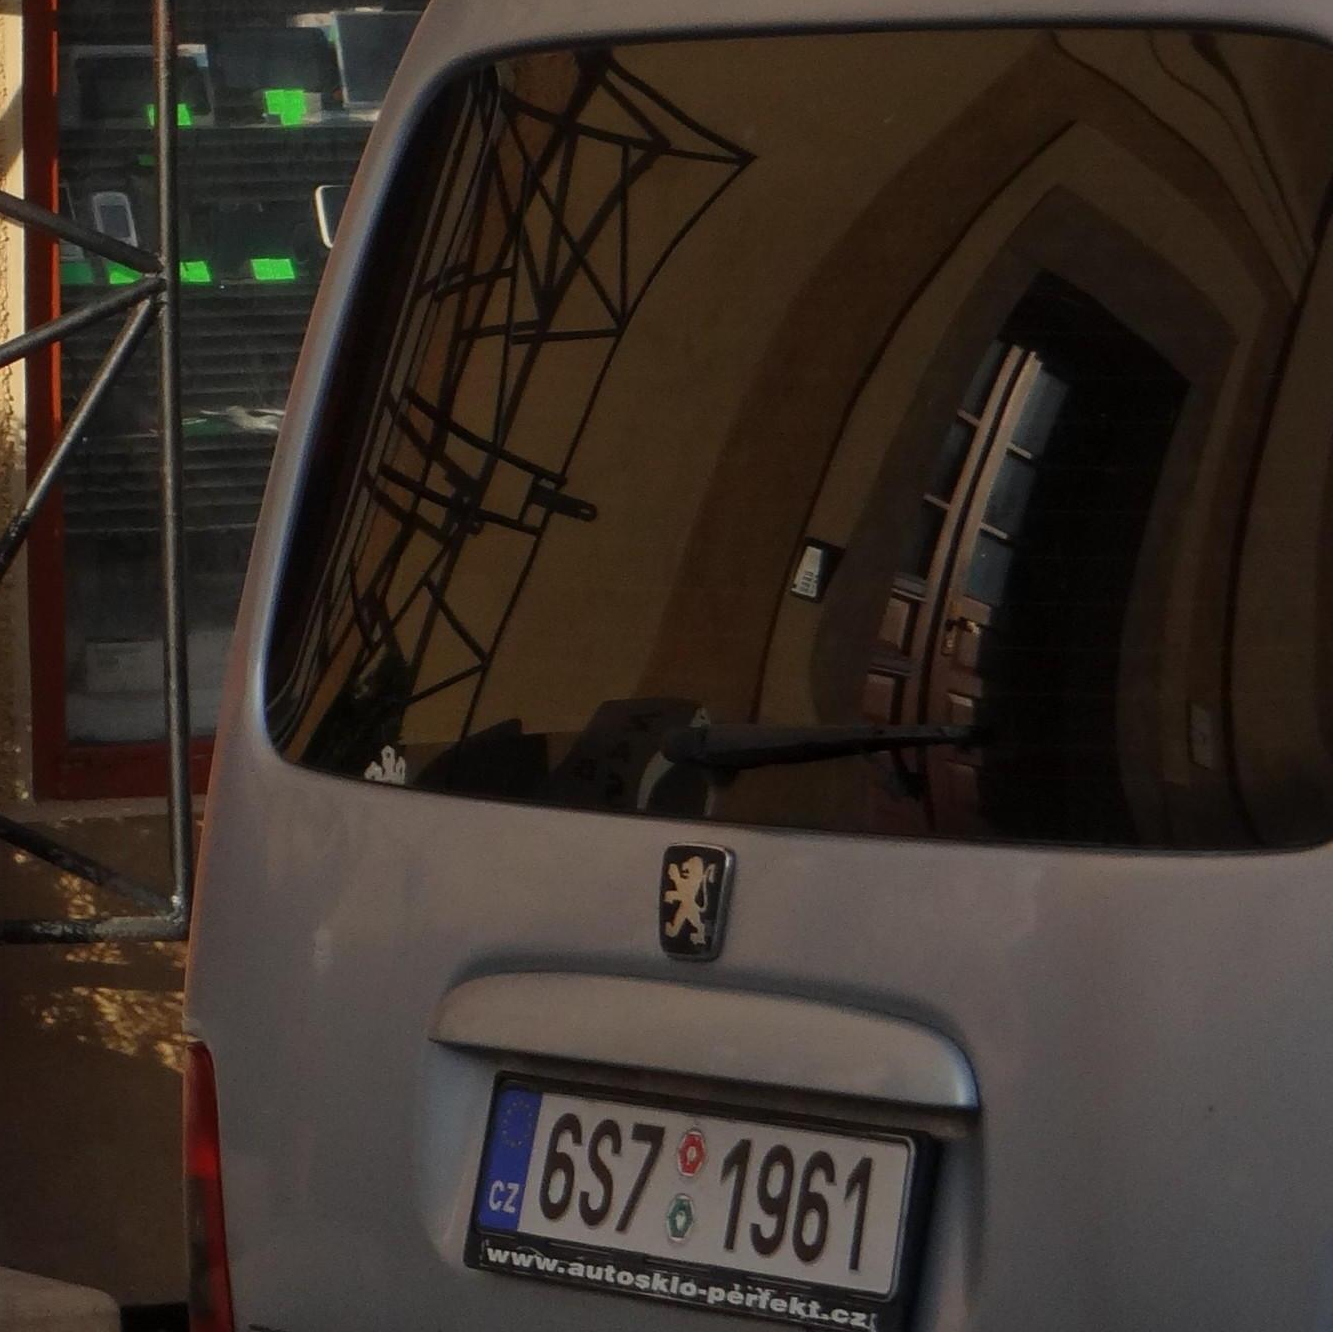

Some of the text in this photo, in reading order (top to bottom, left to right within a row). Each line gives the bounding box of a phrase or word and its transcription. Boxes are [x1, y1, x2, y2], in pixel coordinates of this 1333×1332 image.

[488, 1180, 518, 1215] CZ
[539, 1112, 874, 1272] 6S7 1961
[486, 1244, 868, 1330] www.autosklo-perfekt.cz
